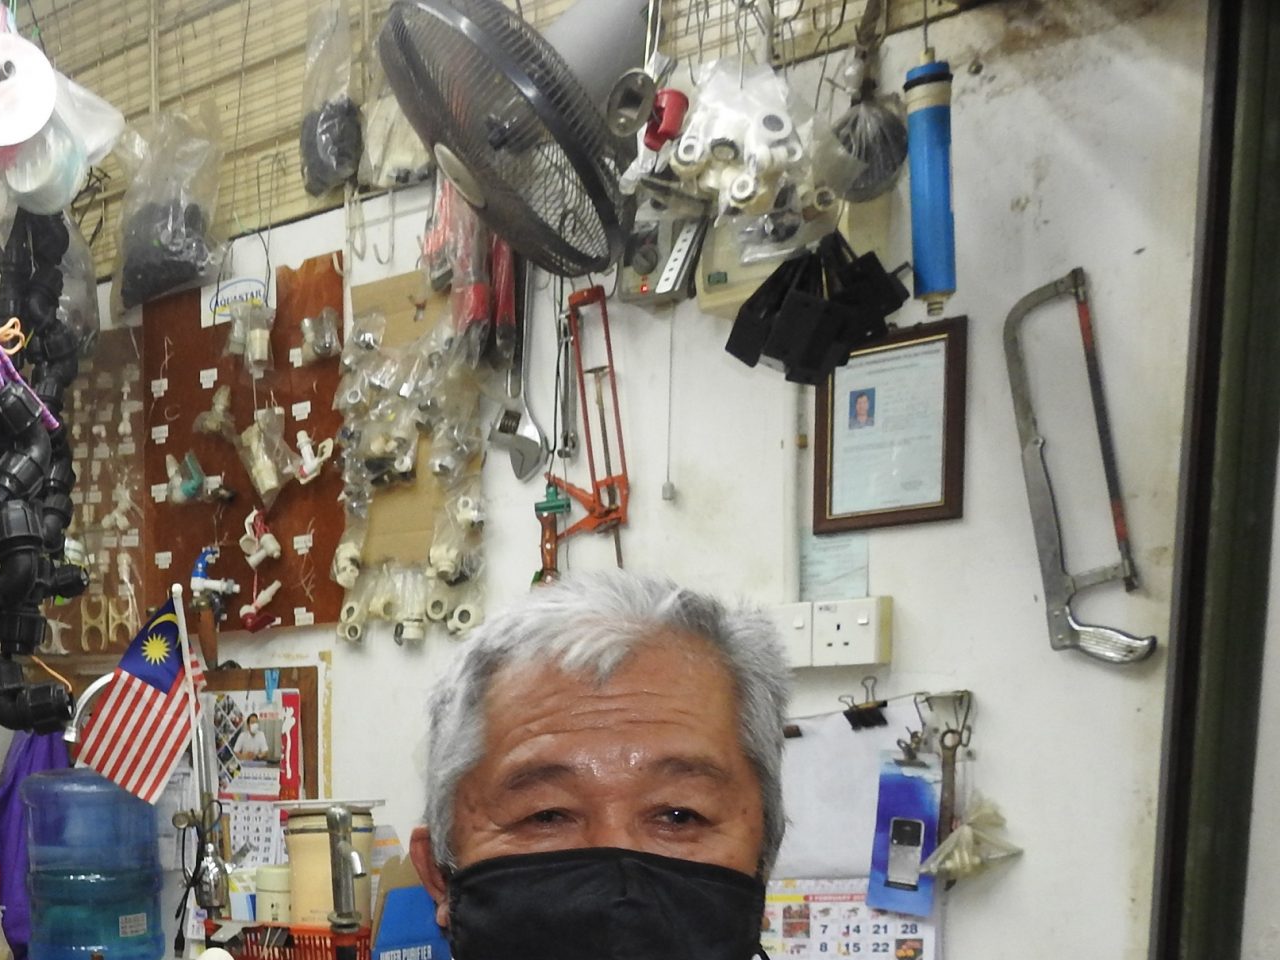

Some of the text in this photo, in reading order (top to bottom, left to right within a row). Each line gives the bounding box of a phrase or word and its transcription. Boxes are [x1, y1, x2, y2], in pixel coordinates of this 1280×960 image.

[820, 924, 918, 934] 7 14 21 28
[819, 943, 889, 952] 8 15 22
